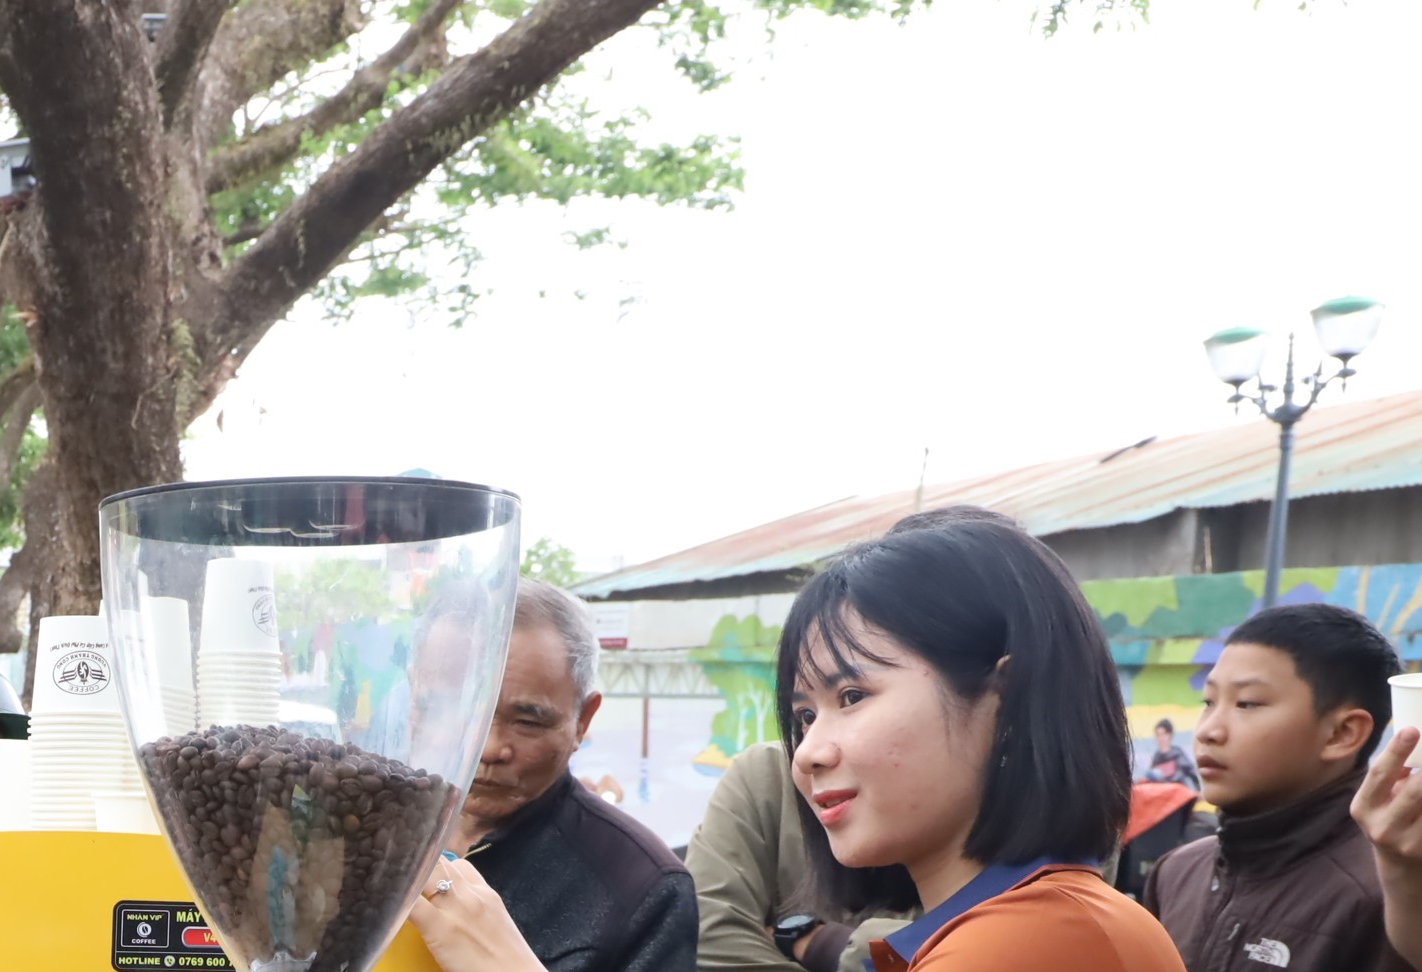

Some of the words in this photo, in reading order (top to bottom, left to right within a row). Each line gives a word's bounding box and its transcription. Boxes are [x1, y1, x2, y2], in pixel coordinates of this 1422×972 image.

[176, 908, 202, 923] MÁY
[118, 956, 161, 966] HOTLINE
[178, 957, 204, 967] 0769
[206, 957, 226, 967] 600
